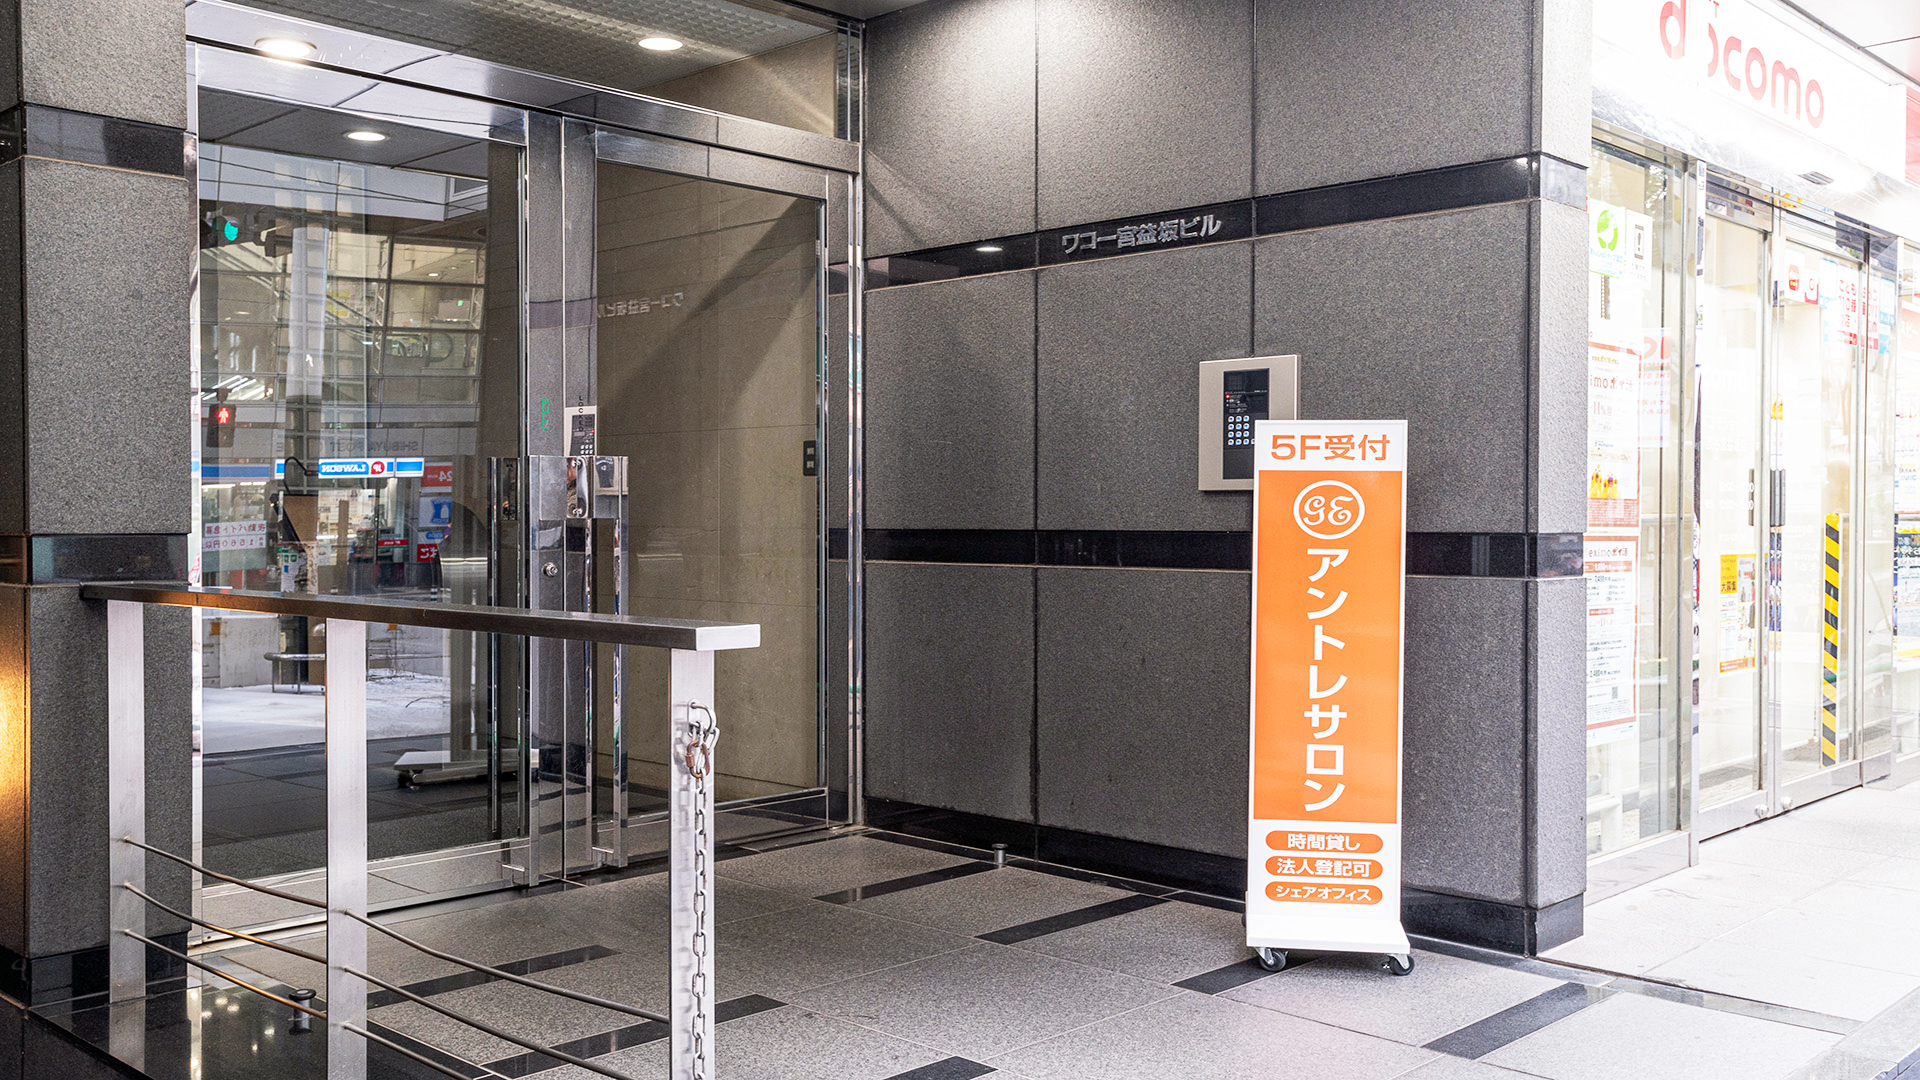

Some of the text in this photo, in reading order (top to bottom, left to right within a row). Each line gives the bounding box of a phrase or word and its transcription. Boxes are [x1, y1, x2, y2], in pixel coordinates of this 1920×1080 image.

[1061, 214, 1222, 254] ワコー宮益坂ビル
[541, 397, 549, 429] PULL
[1271, 434, 1390, 461] 5F受付
[1303, 548, 1349, 812] アントレサロン
[1287, 833, 1361, 851] 時間貸し
[1276, 857, 1372, 877] 法人登記可
[1276, 885, 1372, 902] シェアオフィス
